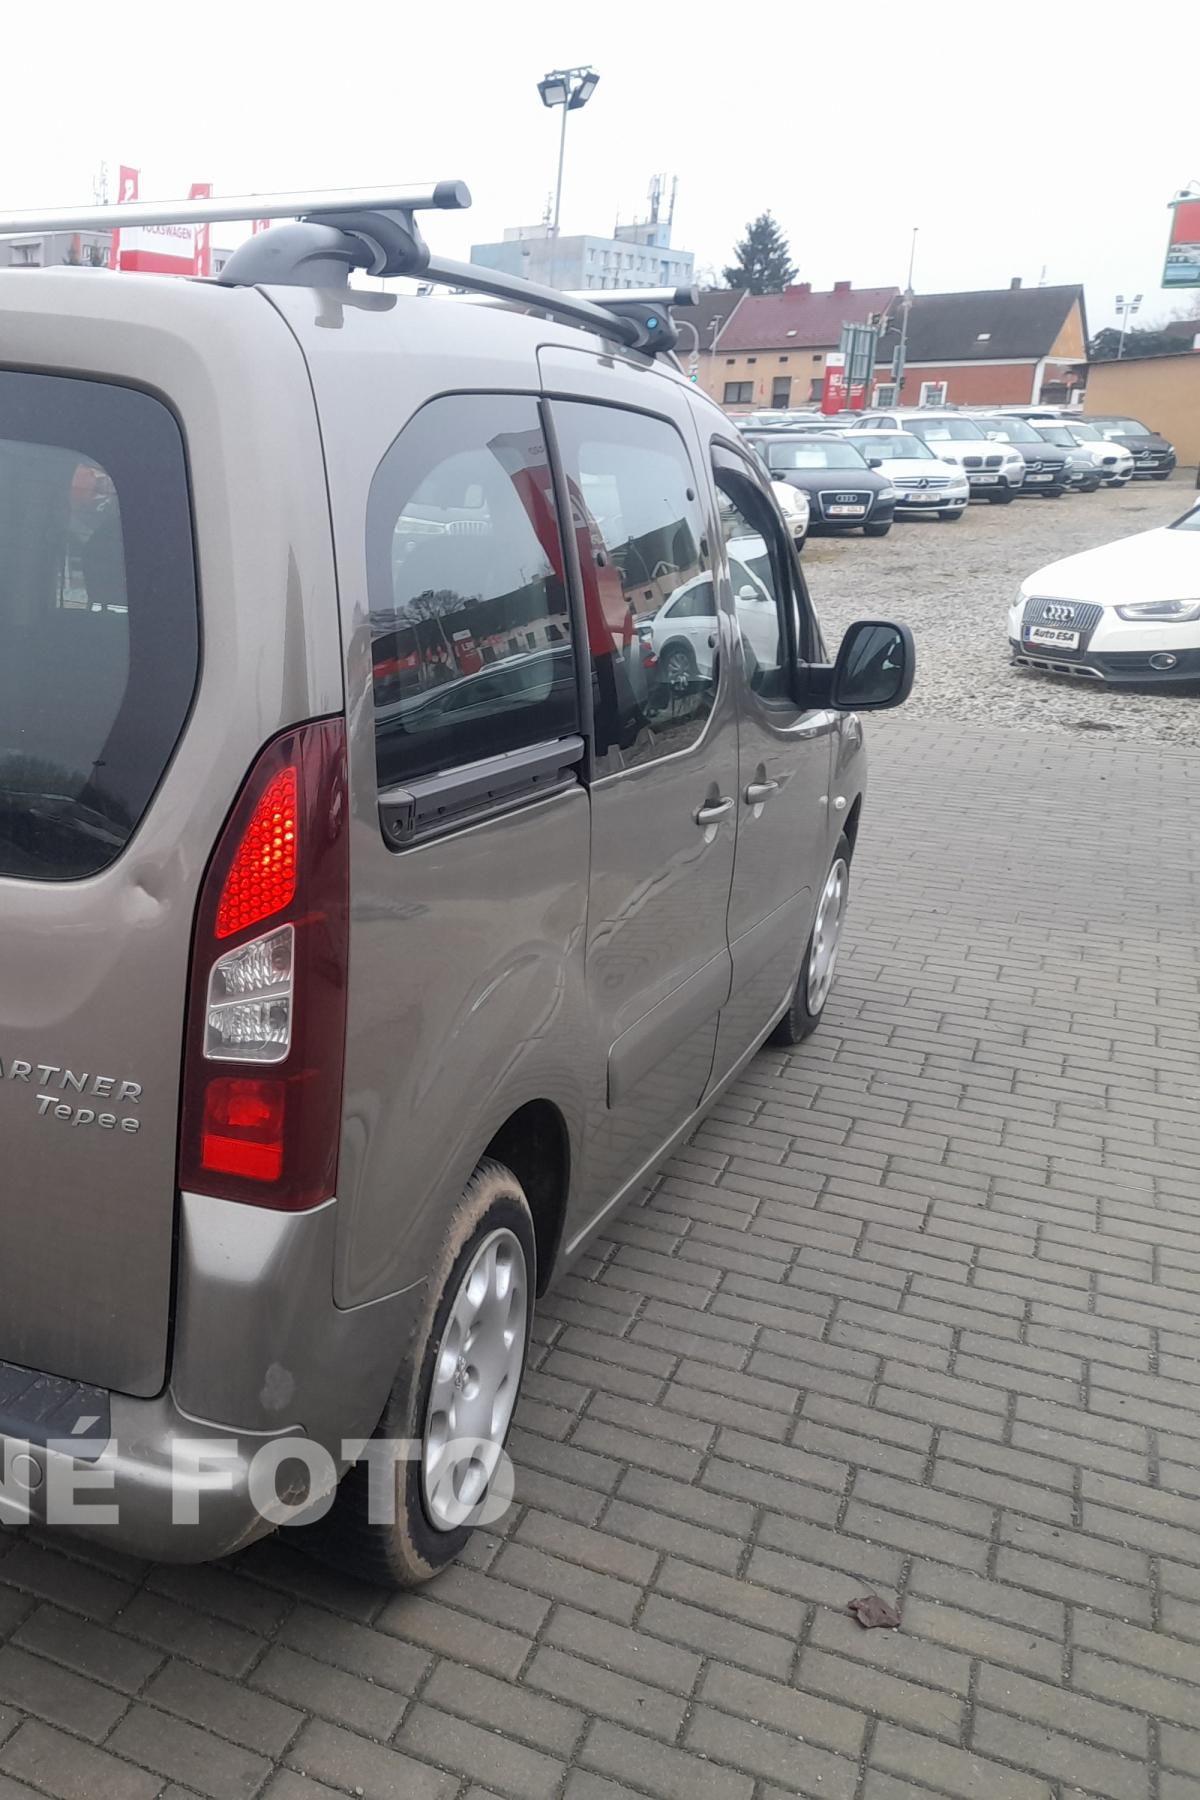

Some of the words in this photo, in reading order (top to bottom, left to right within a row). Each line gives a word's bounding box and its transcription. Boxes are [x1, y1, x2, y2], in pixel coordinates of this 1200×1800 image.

[1033, 628, 1055, 640] Auto
[1056, 631, 1075, 642] ESA
[36, 1094, 141, 1133] Tepee
